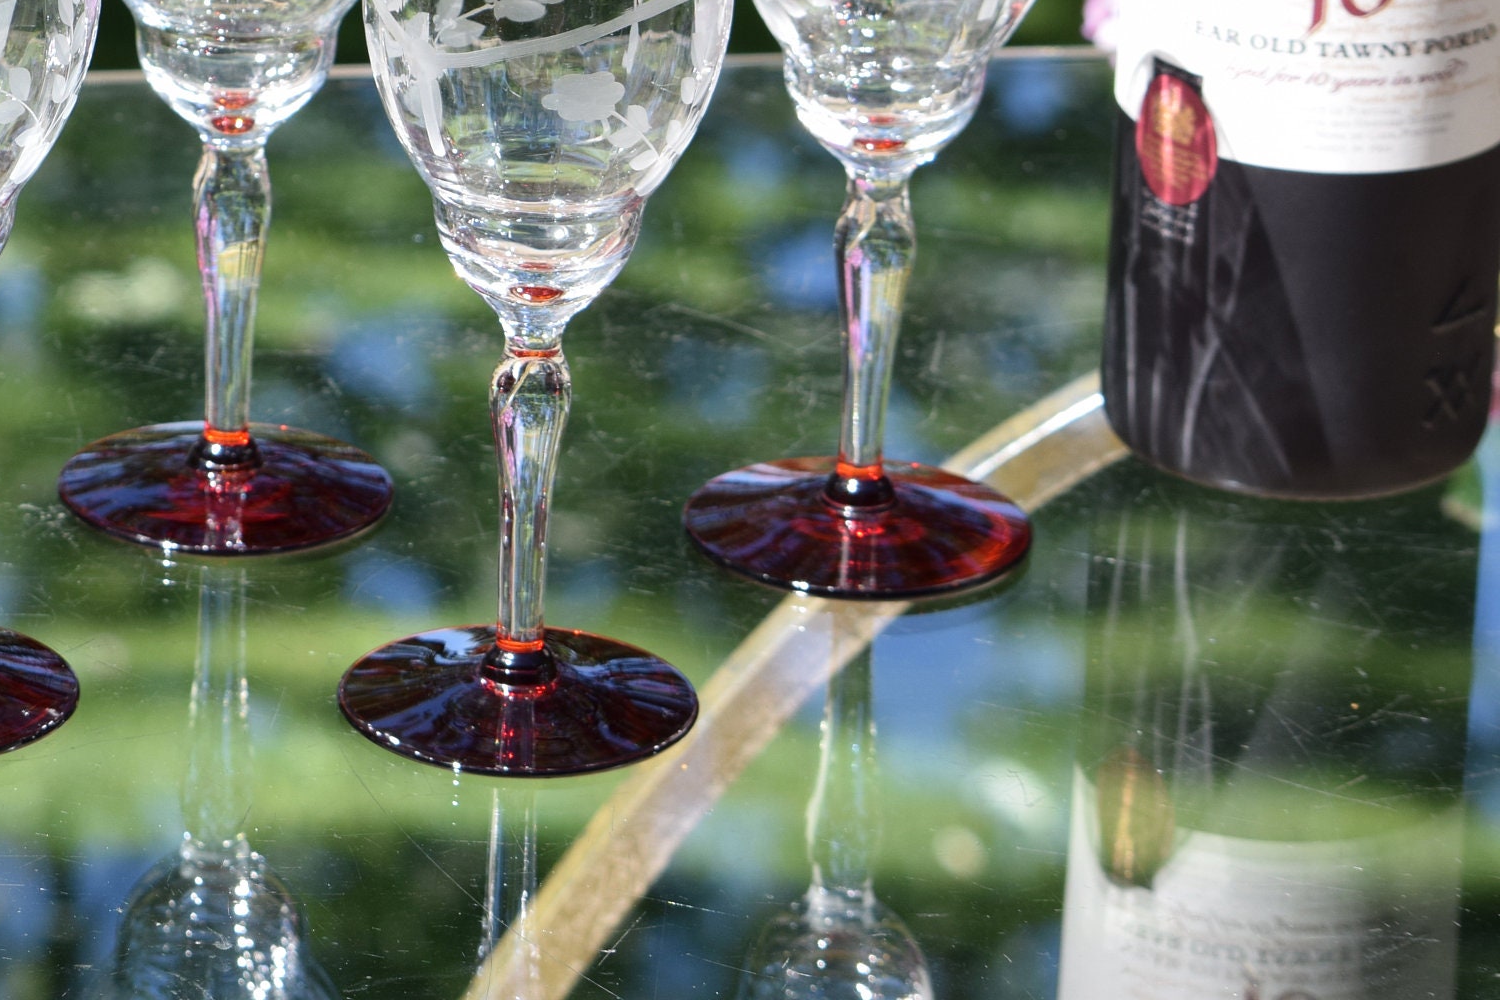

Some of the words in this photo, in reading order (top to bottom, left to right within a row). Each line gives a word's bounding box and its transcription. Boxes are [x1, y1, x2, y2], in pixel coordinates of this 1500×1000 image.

[1249, 33, 1307, 56] OLD
[1313, 40, 1417, 59] TAWNY
[1304, 70, 1331, 87] 10
